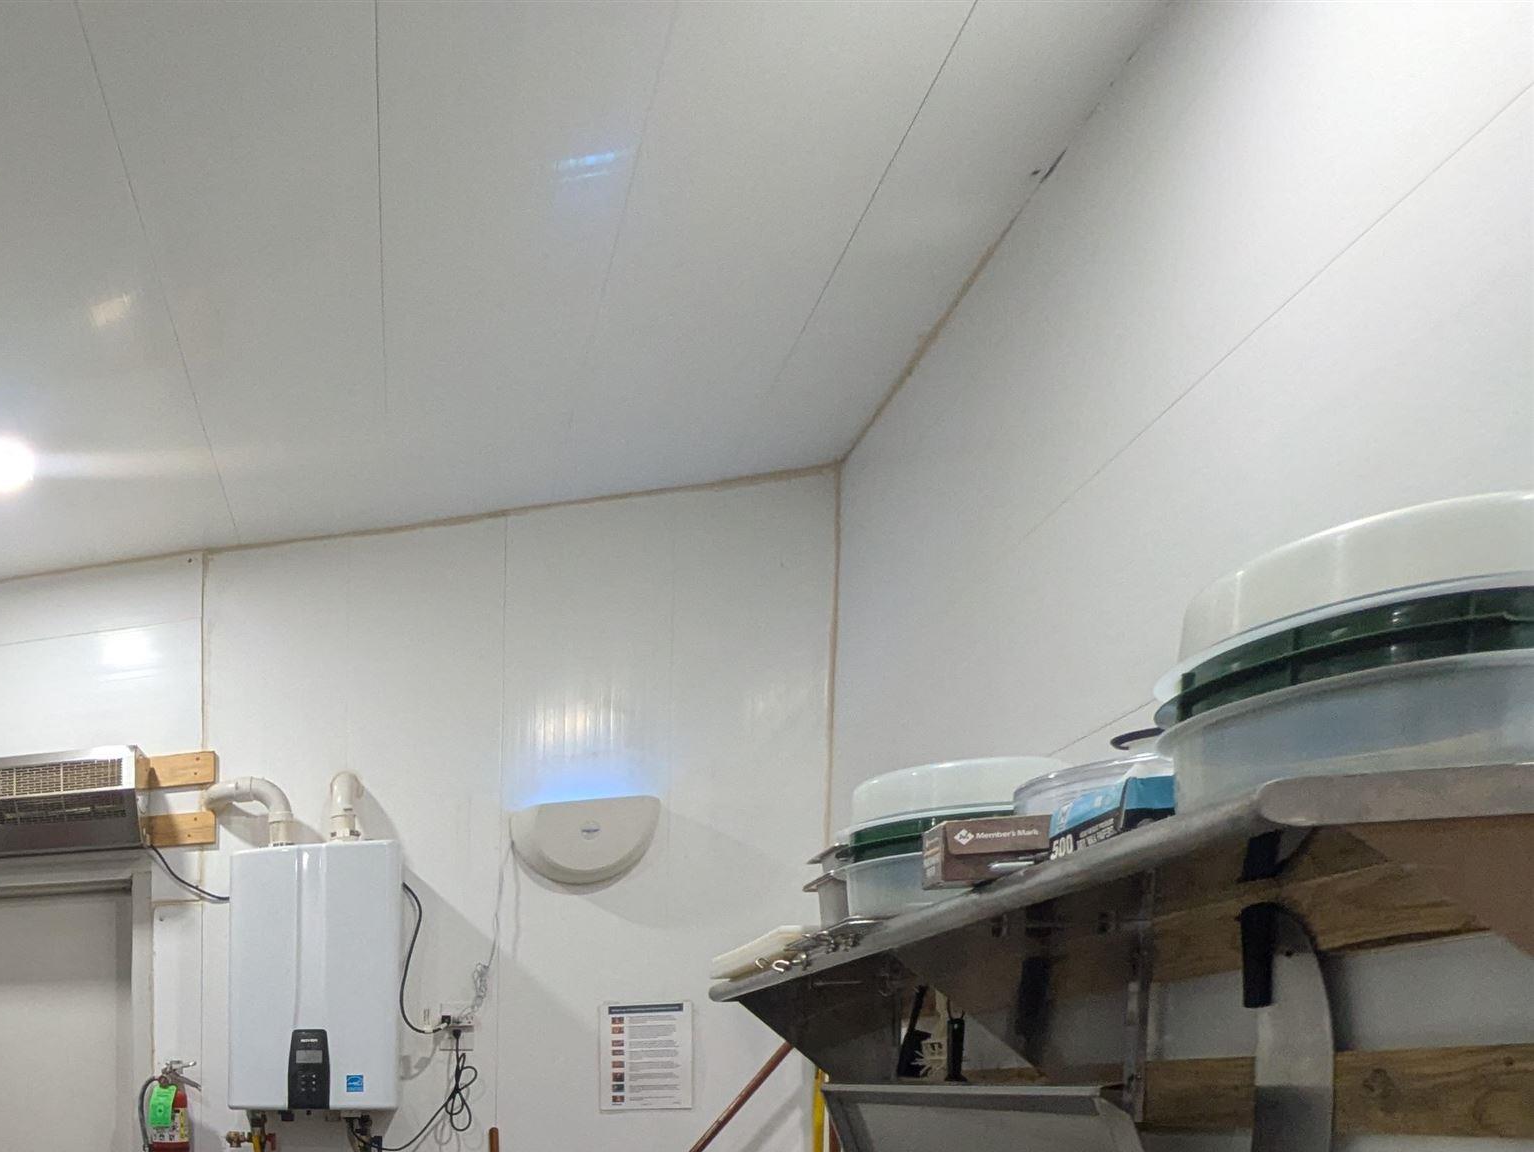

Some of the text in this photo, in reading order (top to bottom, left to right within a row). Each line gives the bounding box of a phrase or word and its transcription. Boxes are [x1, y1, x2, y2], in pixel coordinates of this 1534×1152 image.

[975, 828, 1039, 840] Member's Mark
[1050, 834, 1074, 860] 500
